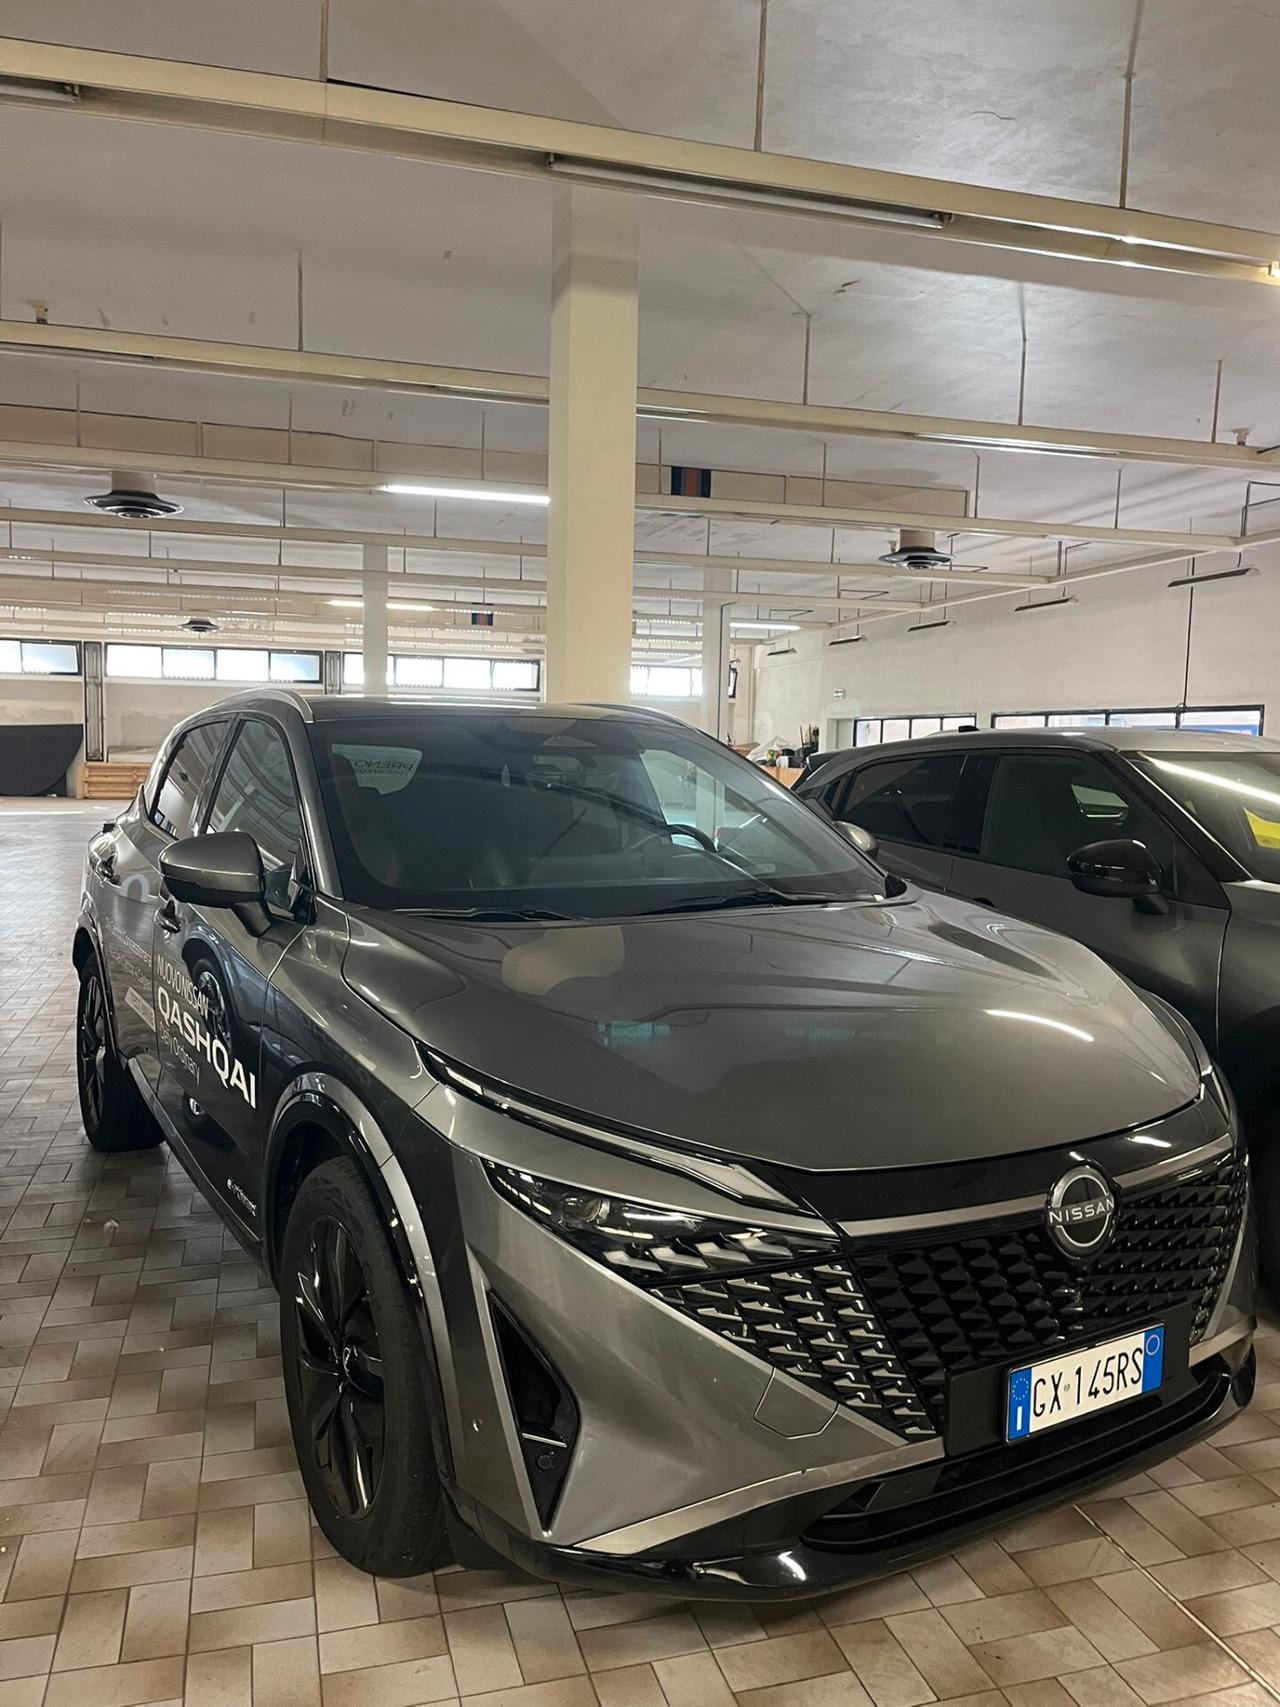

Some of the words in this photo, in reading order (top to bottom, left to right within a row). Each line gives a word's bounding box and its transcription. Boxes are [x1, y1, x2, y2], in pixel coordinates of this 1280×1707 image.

[156, 953, 182, 994] NUOVO
[180, 979, 209, 1020] NISSAN
[157, 985, 257, 1109] QASHQAI
[1049, 1198, 1115, 1226] NISSAN
[1033, 1371, 1063, 1418] GX
[1075, 1347, 1143, 1405] 145RS
